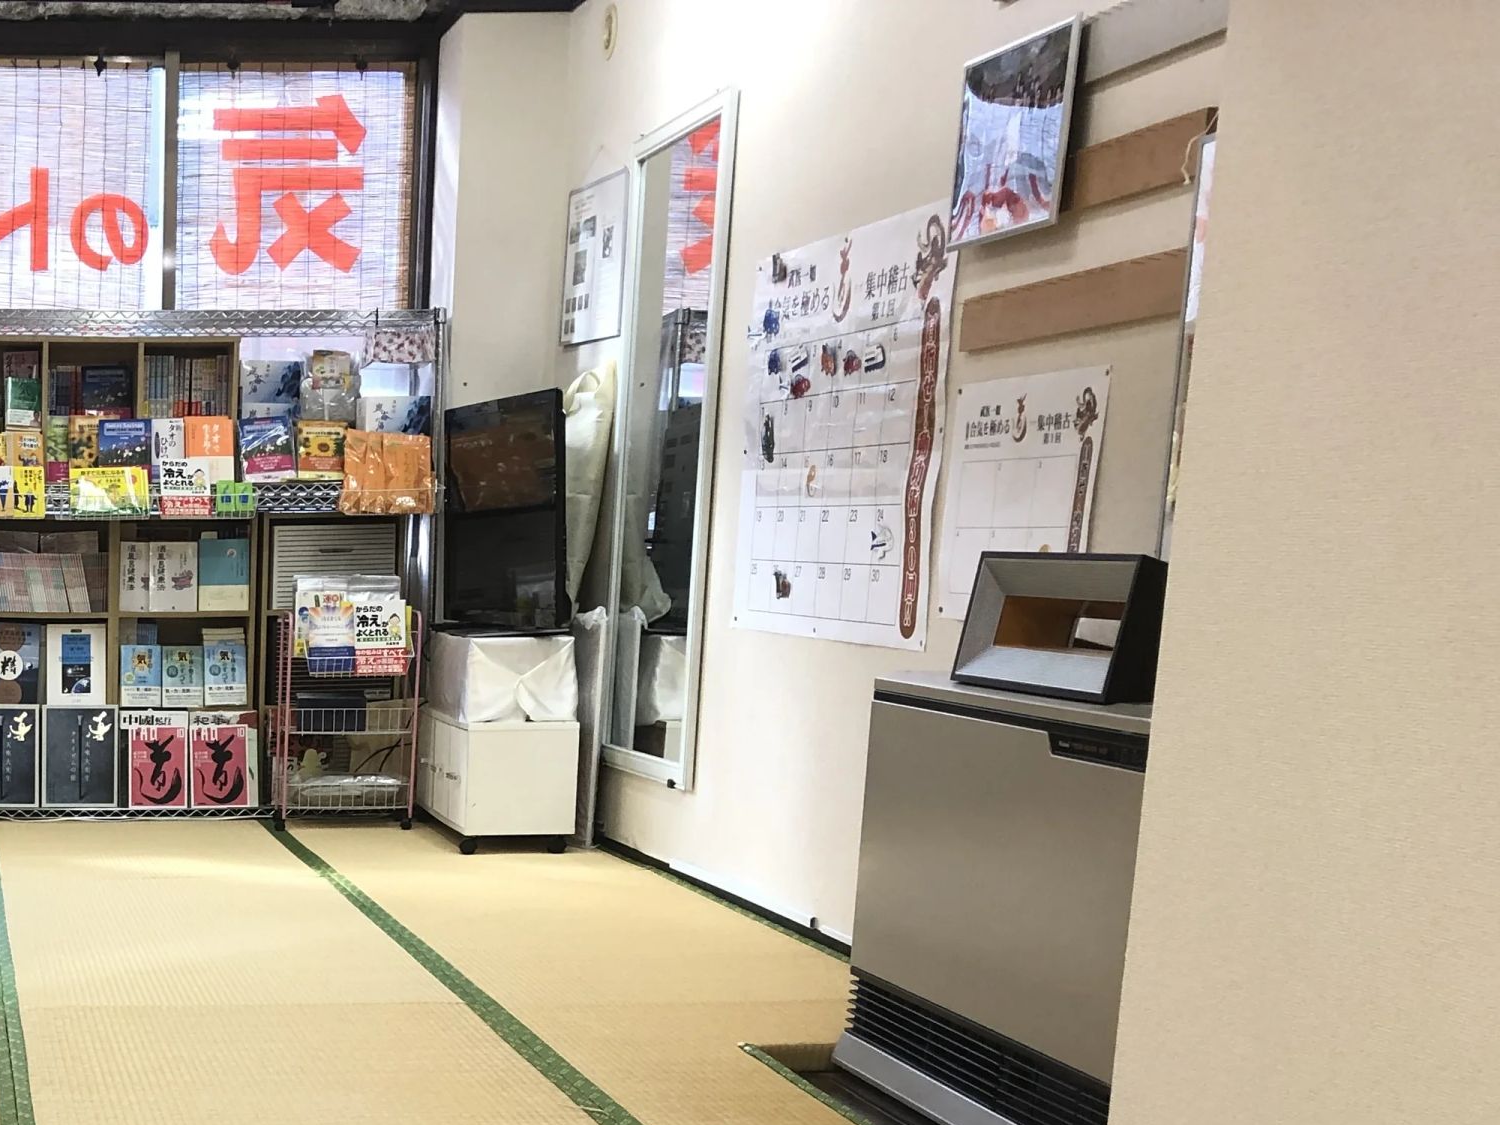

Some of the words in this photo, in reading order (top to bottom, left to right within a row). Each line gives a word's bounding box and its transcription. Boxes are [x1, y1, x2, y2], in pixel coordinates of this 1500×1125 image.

[355, 628, 389, 637] よくとれる
